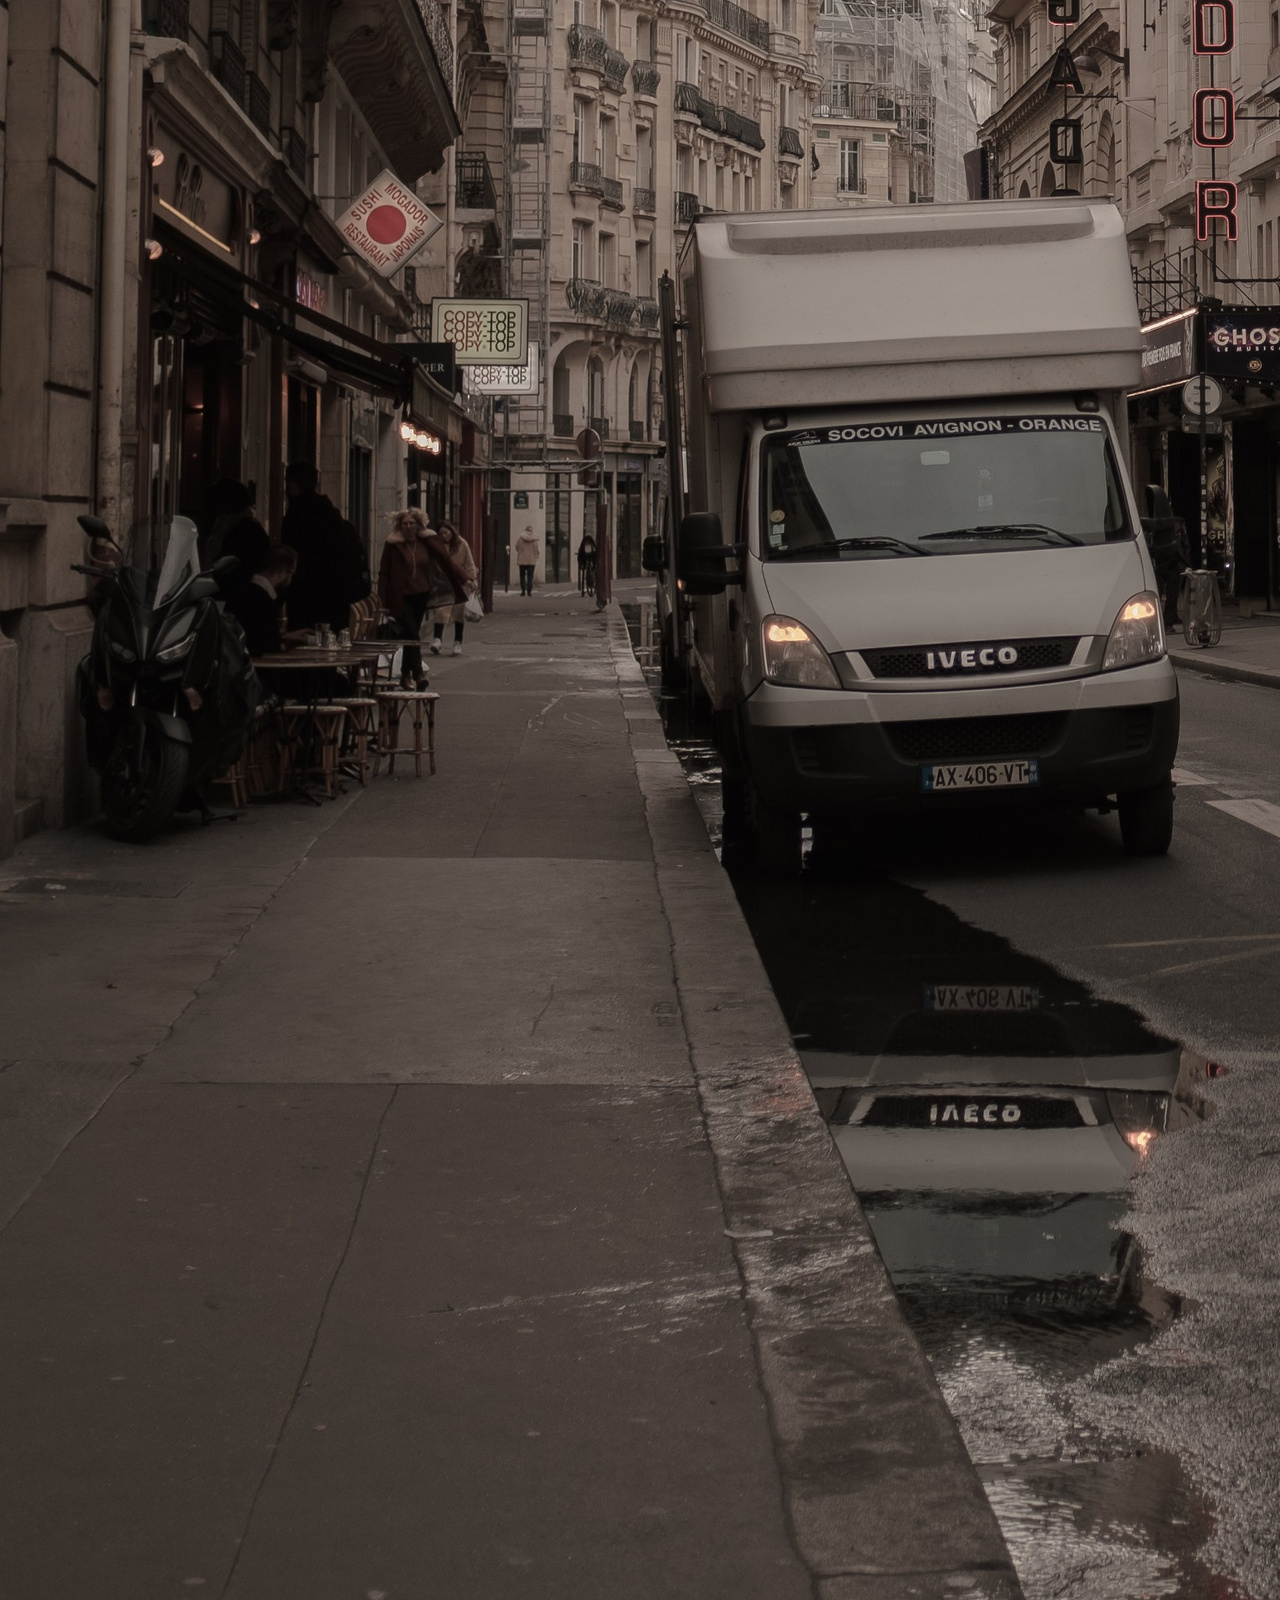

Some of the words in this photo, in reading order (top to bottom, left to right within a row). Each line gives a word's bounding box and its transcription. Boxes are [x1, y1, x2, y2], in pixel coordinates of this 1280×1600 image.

[351, 189, 382, 221] SUSHI
[384, 182, 428, 226] MOGADOR
[344, 223, 390, 267] RESTAURANT
[390, 226, 425, 262] JAPONAIS
[444, 310, 516, 322] COPY-TOP
[444, 320, 516, 332] COPY-TOP
[444, 330, 516, 342] COPY-TOP
[828, 426, 904, 443] SOCOVI
[914, 420, 1002, 436] AVIGNON
[1019, 419, 1102, 432] ORANGE
[927, 646, 1018, 670] IVECO
[935, 763, 1026, 787] AX-406-VT
